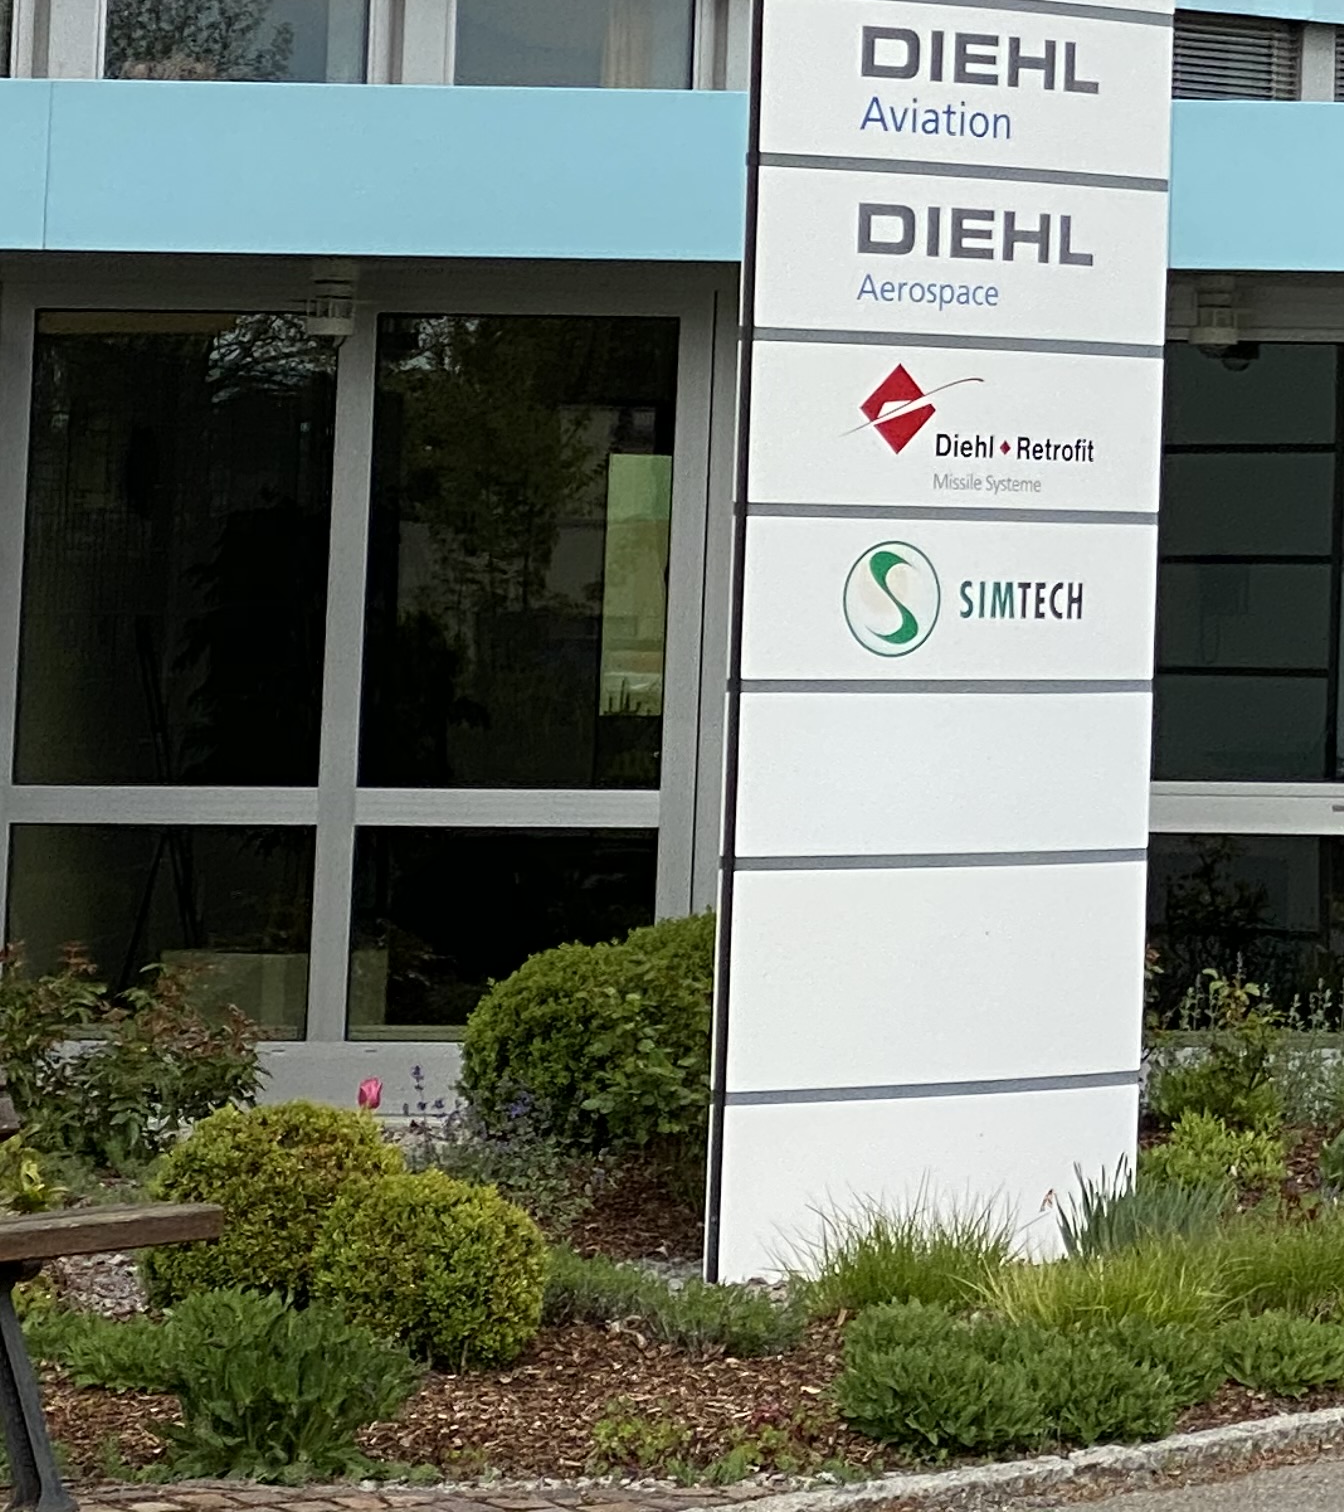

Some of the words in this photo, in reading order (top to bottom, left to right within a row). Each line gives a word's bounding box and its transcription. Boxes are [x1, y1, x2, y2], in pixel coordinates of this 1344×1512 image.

[860, 25, 1100, 95] DIEHL
[859, 96, 1012, 140] Aviation
[857, 202, 1094, 267] DIEHL
[856, 273, 1000, 311] Aerospace
[935, 433, 995, 459] Diehl
[1016, 436, 1095, 463] Retrofit
[932, 473, 983, 491] Missile
[985, 475, 1042, 495] Systeme
[959, 580, 1084, 620] SIMTECH
